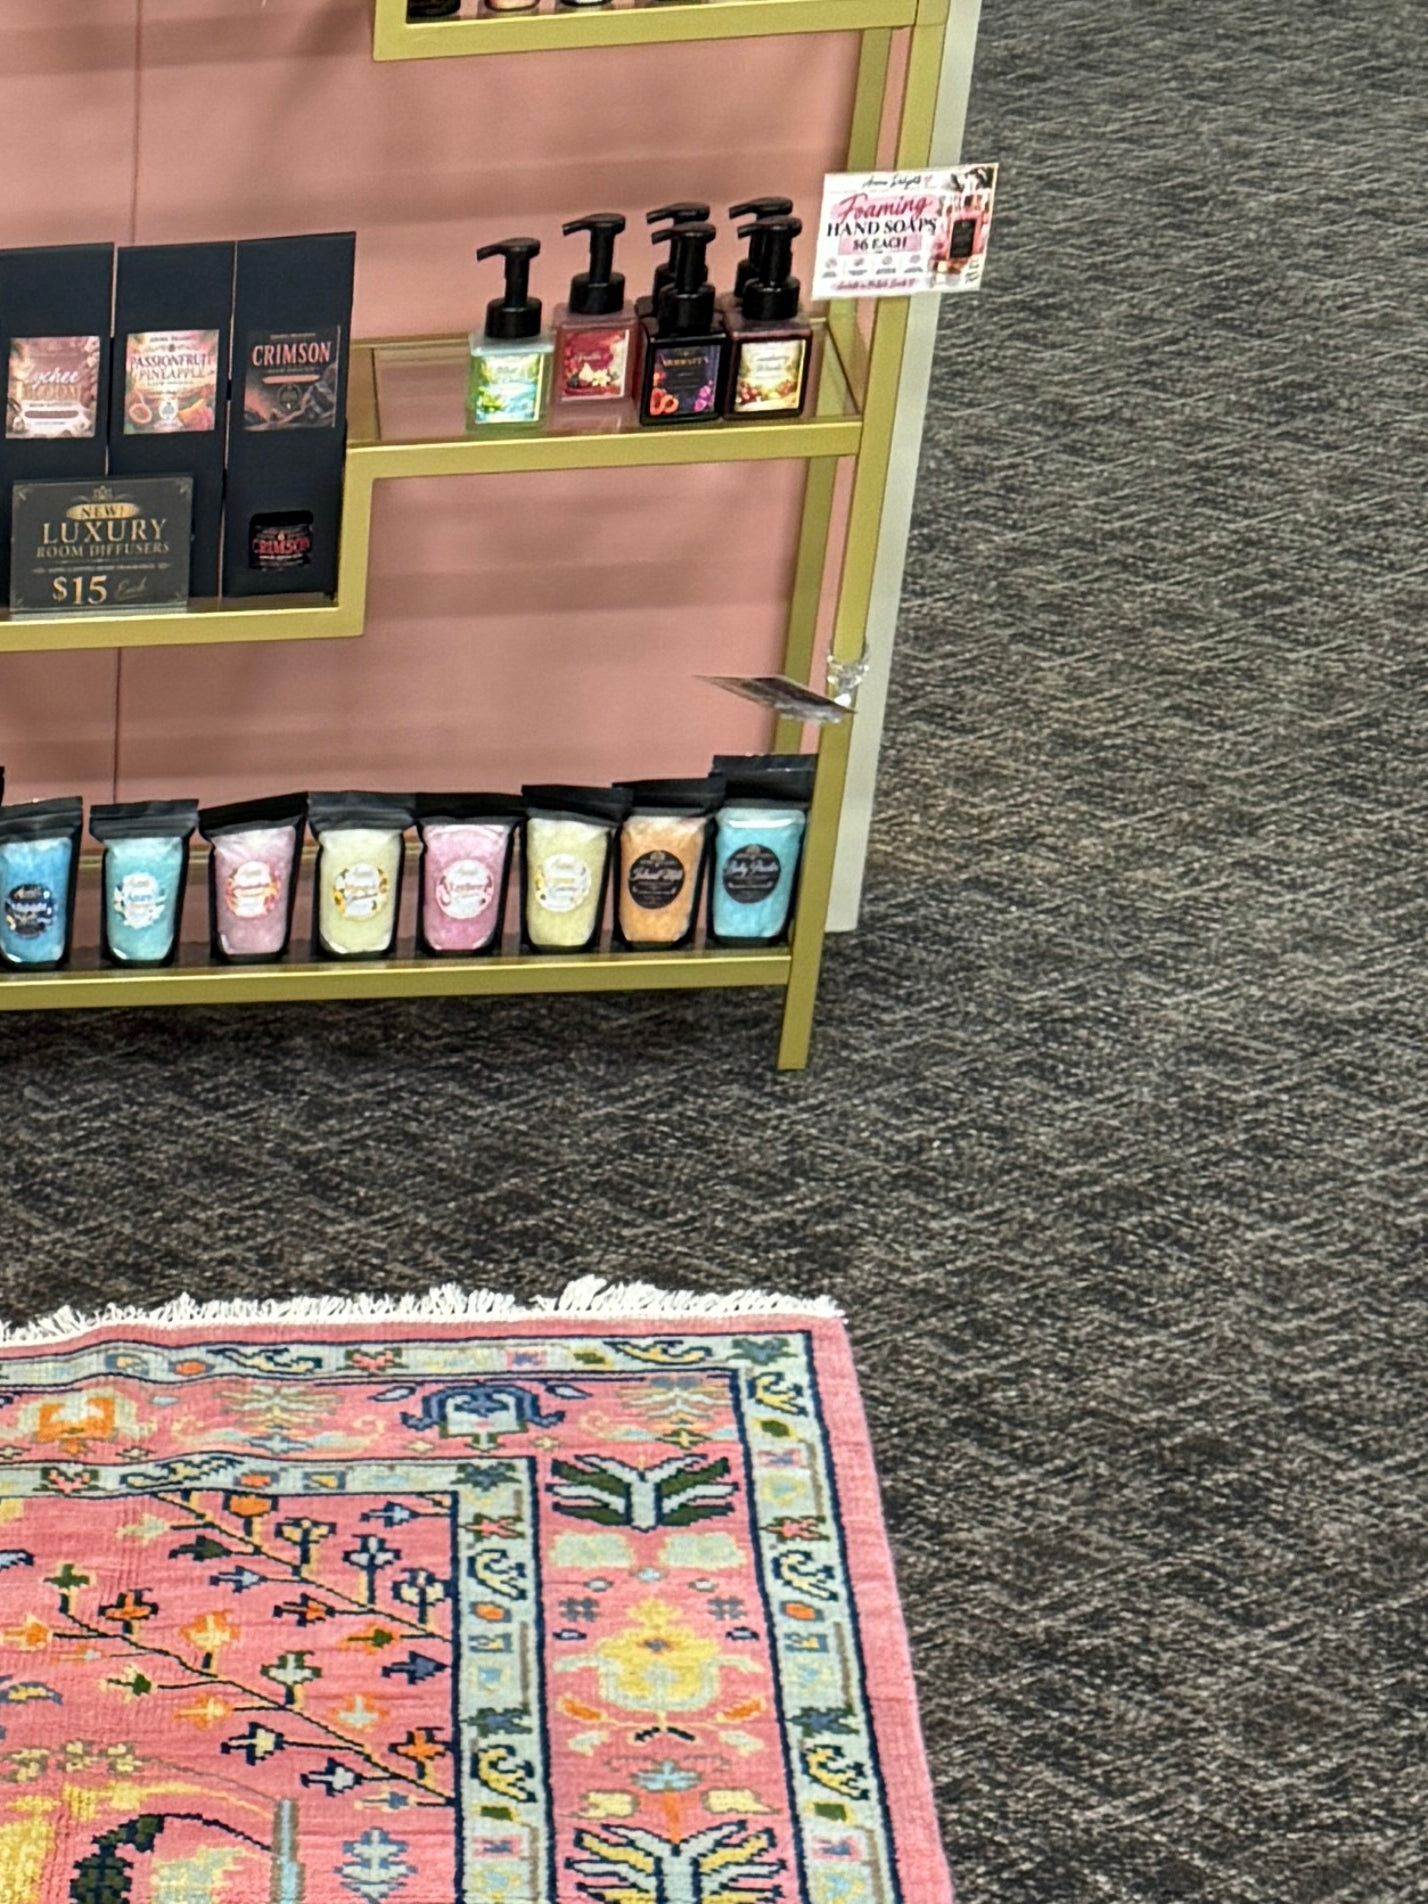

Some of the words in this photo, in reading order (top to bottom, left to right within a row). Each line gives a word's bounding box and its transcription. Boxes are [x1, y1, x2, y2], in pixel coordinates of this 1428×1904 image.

[837, 192, 933, 223] Foaming
[827, 220, 880, 237] HAND
[883, 217, 937, 236] SOAPS
[852, 238, 869, 251] $6
[872, 236, 908, 249] EACH
[131, 352, 212, 368] PASSIONFRUIT
[252, 341, 332, 366] CRIMSON
[81, 503, 125, 519] NEW!
[43, 519, 167, 545] LUXURY
[36, 545, 84, 559] ROOM
[89, 542, 170, 557] DIFFUSERS
[52, 575, 108, 606] $15
